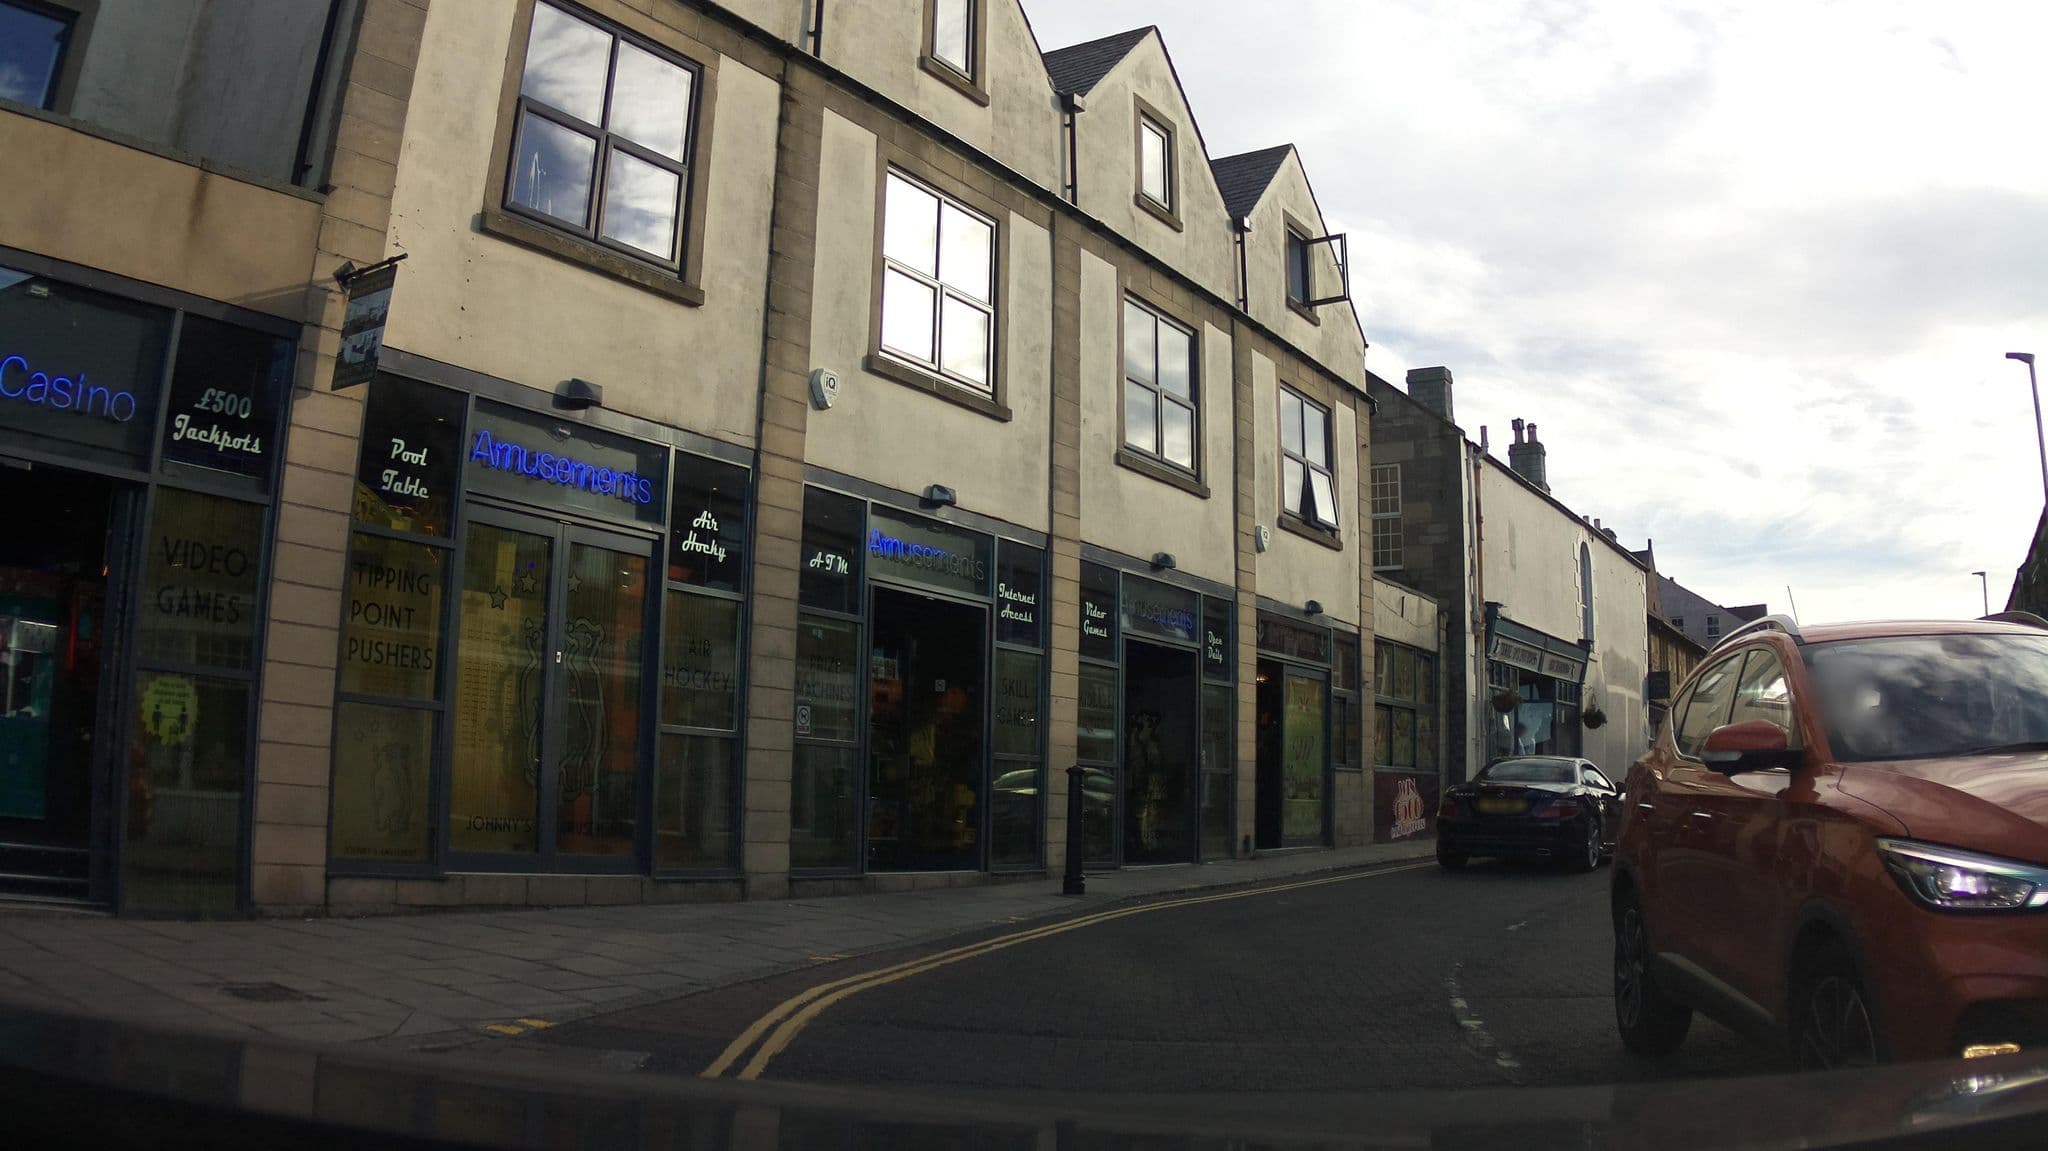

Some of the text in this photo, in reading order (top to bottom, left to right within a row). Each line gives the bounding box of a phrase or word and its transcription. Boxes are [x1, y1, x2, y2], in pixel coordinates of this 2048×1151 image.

[0, 354, 136, 423] Casino
[194, 387, 252, 421] £500
[172, 414, 263, 455] Jackpots
[391, 438, 430, 467] Pool
[470, 430, 653, 505] Amusements
[381, 468, 430, 499] Table
[692, 510, 719, 532] Air
[164, 536, 247, 577] VIDEO
[810, 552, 849, 575] ATM
[869, 528, 985, 581] Amusements
[353, 560, 431, 596] TIPPING
[157, 586, 241, 624] GAMES
[998, 583, 1036, 605] Internet
[351, 601, 415, 630] POINT
[1001, 604, 1033, 623] Access
[1085, 601, 1107, 620] Video
[1084, 620, 1109, 639] Games
[1208, 631, 1223, 646] Open
[347, 638, 434, 671] PUSHERS
[689, 640, 712, 657] AIR
[1208, 647, 1223, 664] Daily
[665, 667, 732, 690] HOCKEY
[1001, 679, 1029, 698] SKILL
[466, 815, 534, 833] JOHNNY'S
